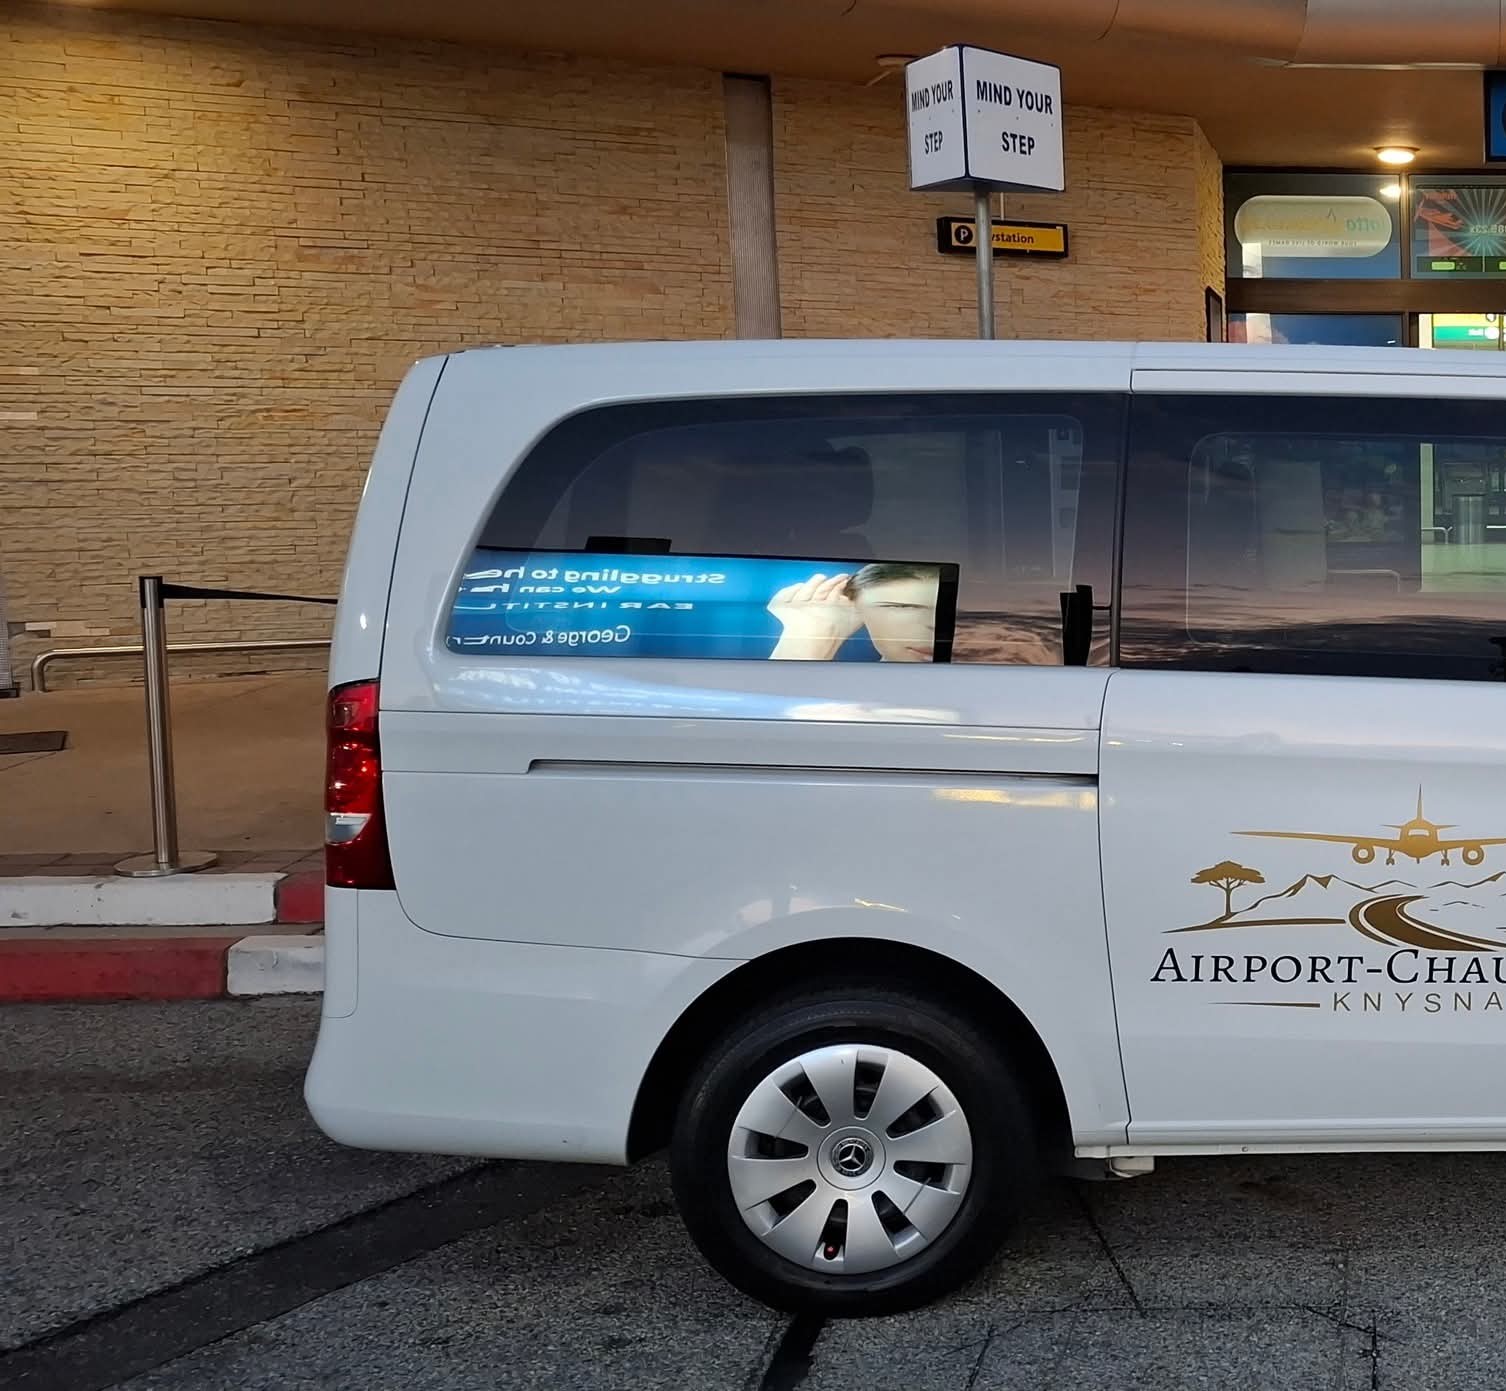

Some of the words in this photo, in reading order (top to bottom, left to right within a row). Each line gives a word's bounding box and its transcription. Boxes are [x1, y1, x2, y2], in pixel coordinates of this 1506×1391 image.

[912, 87, 930, 112] MIND
[931, 80, 953, 104] YOUR
[976, 80, 1012, 106] MIND
[1016, 88, 1053, 115] YOUR
[925, 130, 943, 154] STEP
[1001, 131, 1035, 156] STEP
[1332, 991, 1504, 1014] KNYSNA
